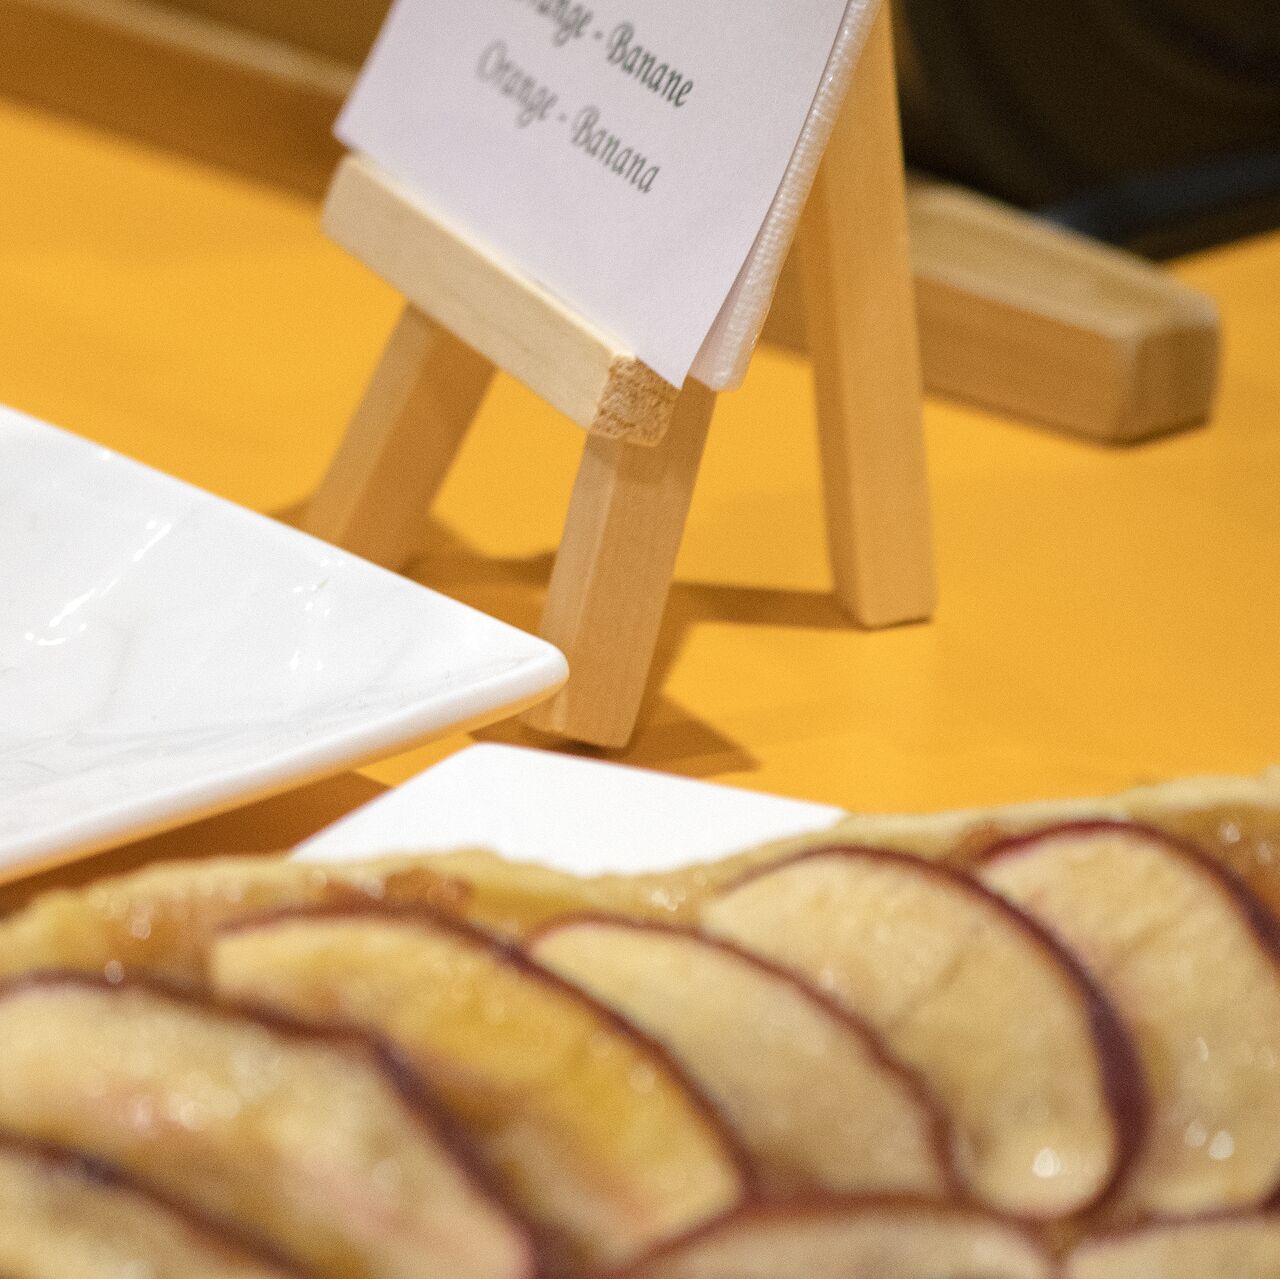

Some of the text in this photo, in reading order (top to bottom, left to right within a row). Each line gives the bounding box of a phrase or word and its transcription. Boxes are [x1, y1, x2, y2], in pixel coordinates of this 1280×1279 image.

[476, 38, 559, 128] Orange
[571, 105, 661, 194] Banana
[606, 21, 694, 108] Banane
